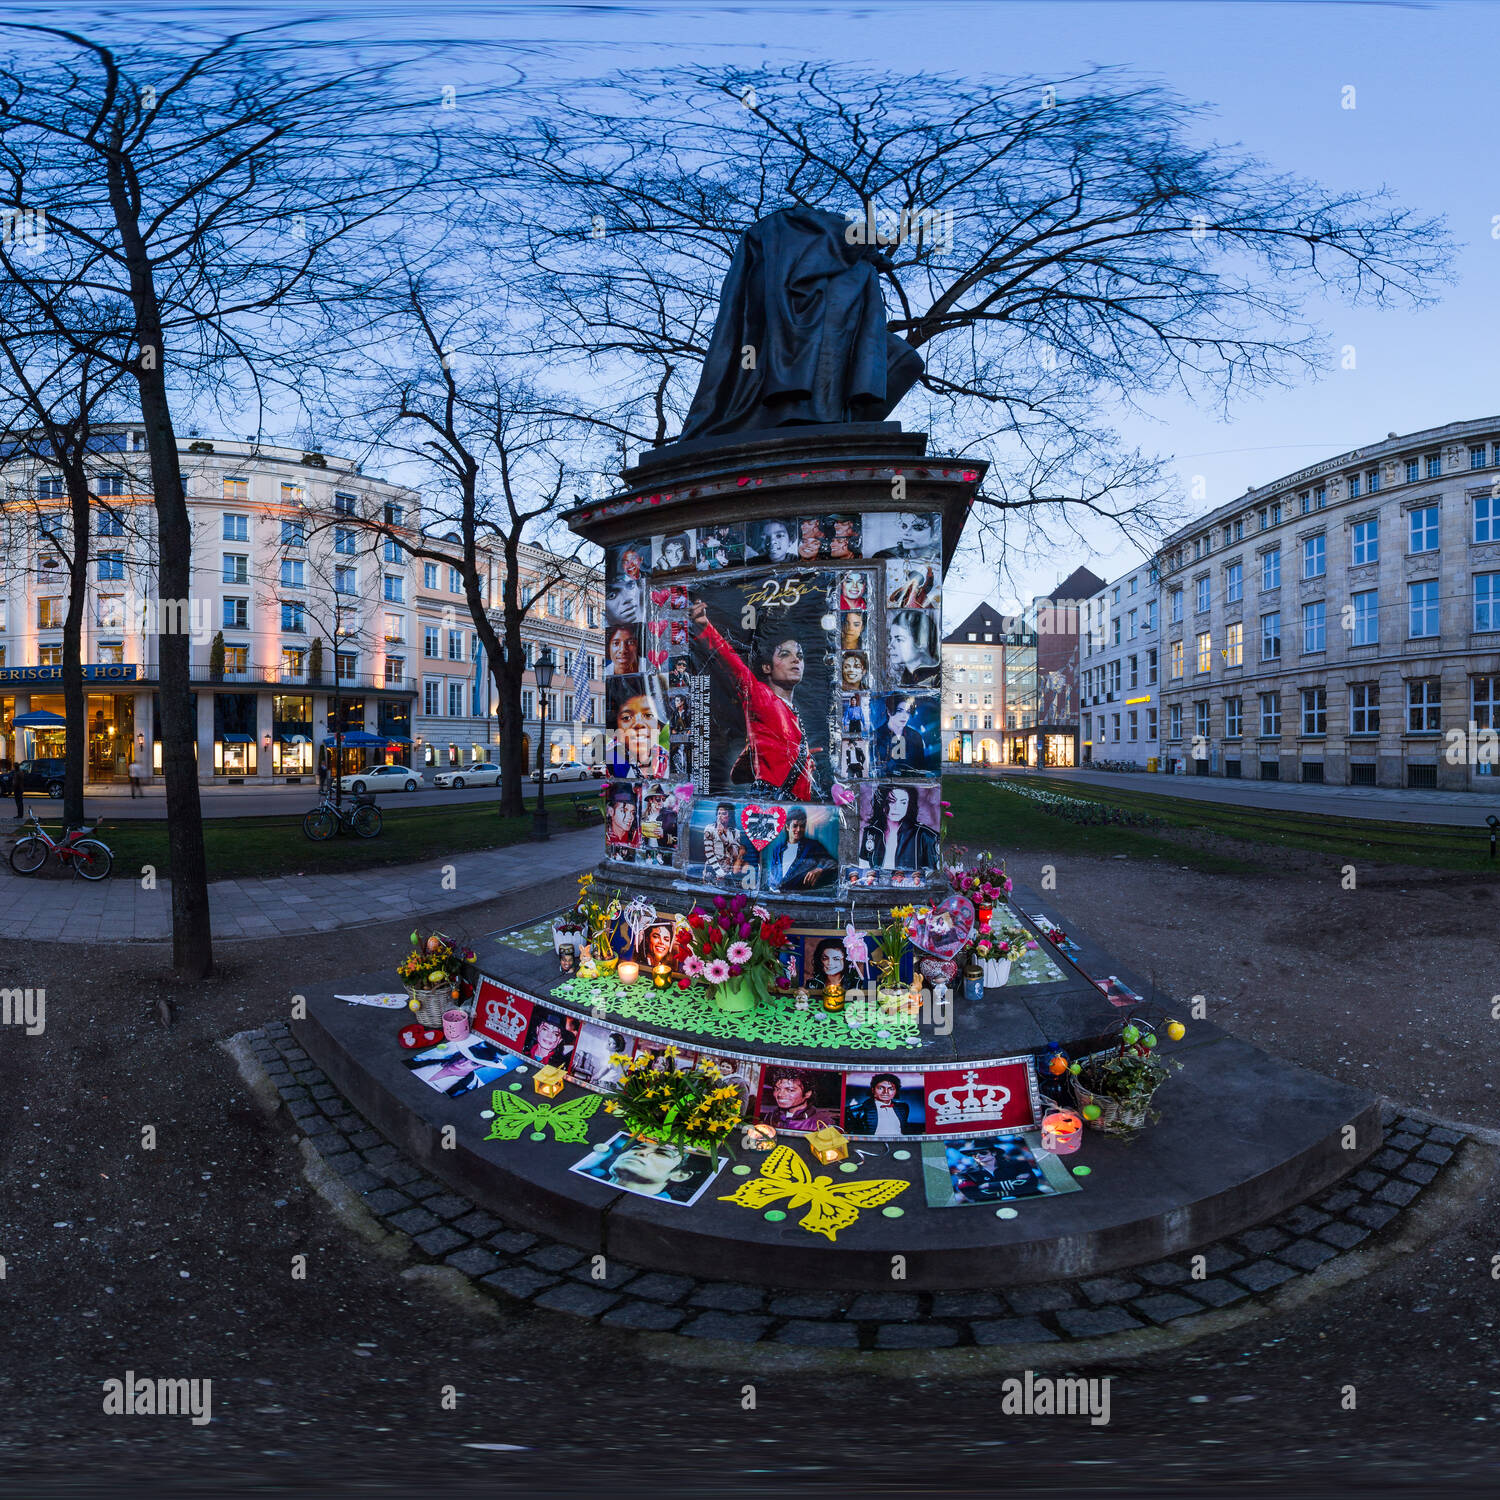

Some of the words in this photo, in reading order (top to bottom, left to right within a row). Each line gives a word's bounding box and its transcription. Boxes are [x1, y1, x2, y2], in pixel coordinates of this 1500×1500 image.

[762, 579, 800, 606] 25
[0, 666, 87, 681] ERISCHR
[95, 666, 133, 678] HOF
[694, 701, 700, 709] OF
[704, 706, 710, 714] OF
